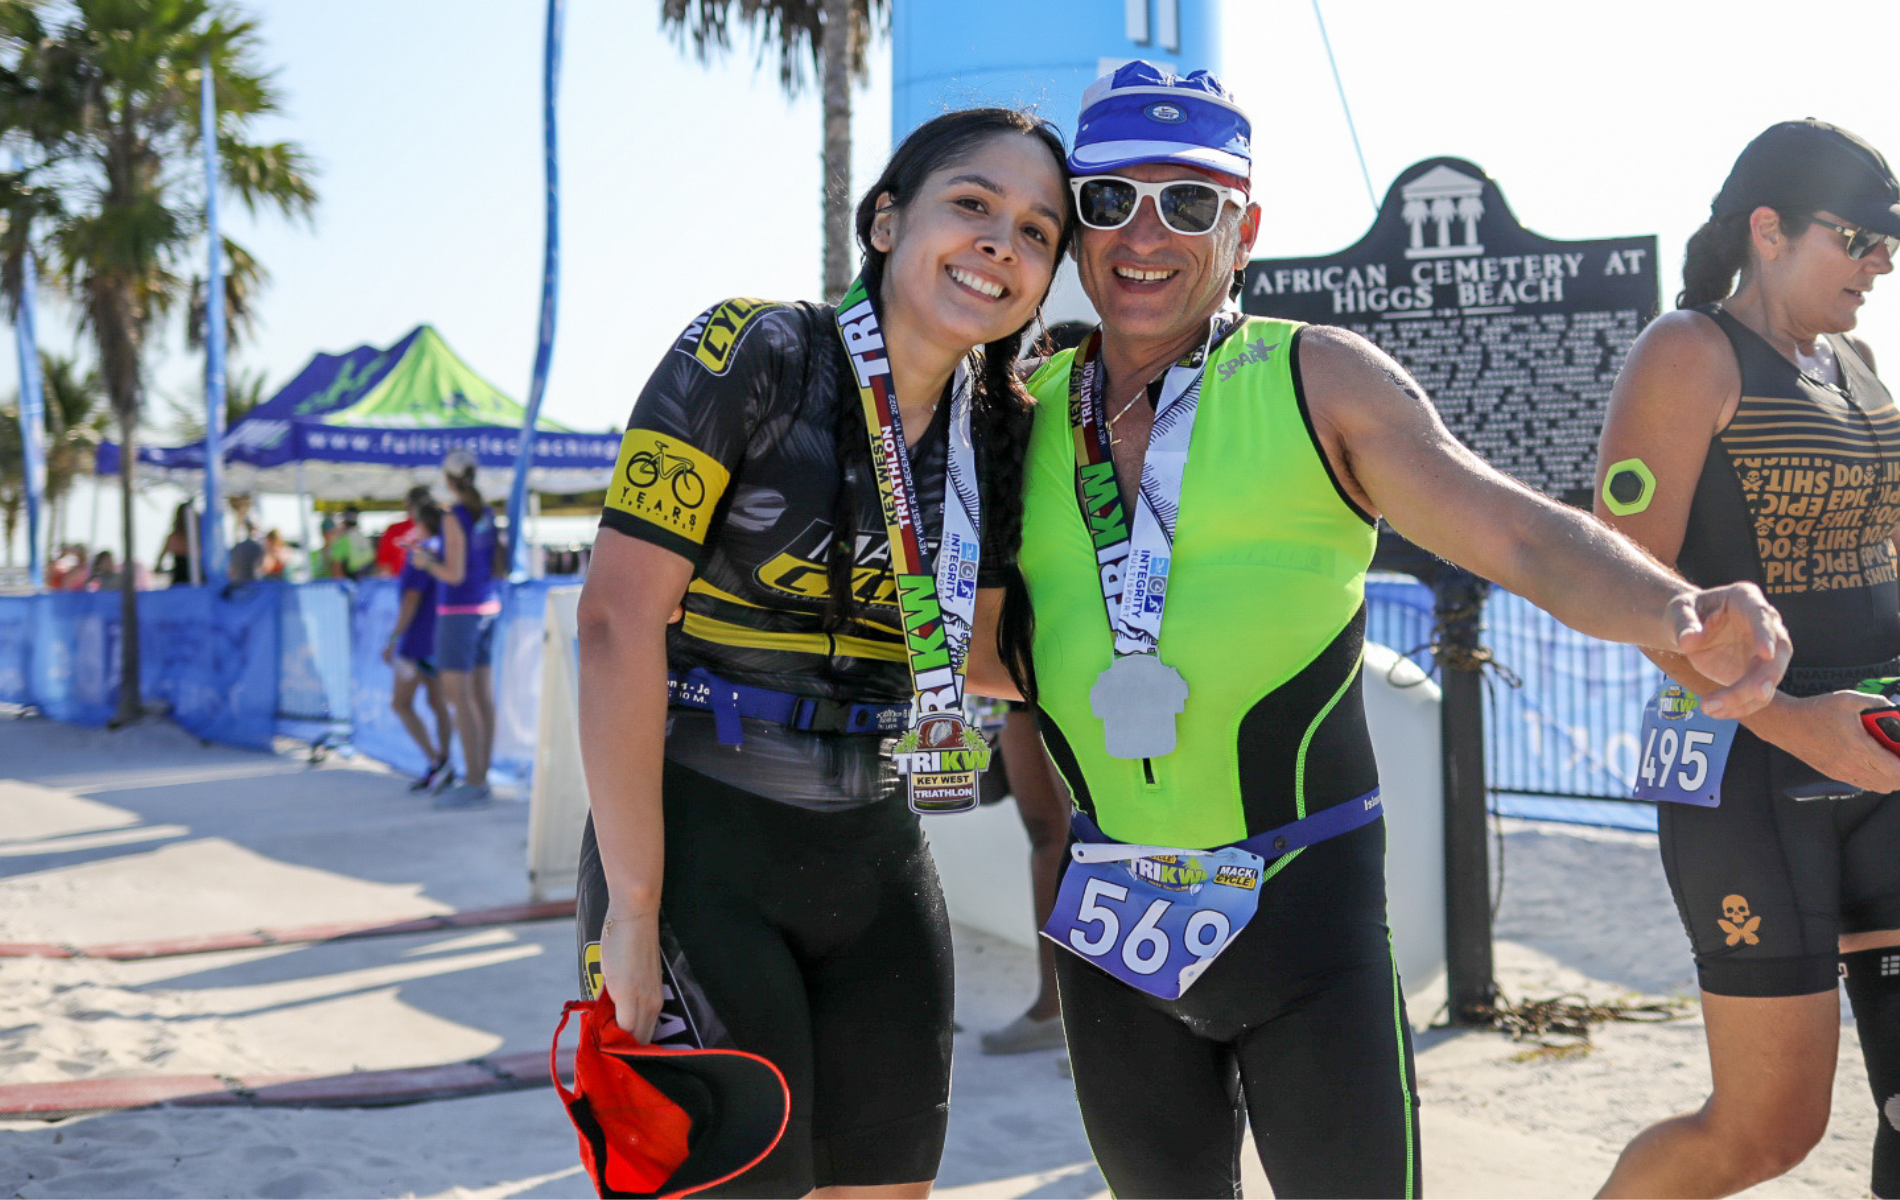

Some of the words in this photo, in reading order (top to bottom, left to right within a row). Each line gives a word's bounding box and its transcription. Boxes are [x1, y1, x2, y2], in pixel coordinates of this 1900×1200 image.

[1253, 264, 1387, 295] AFRICAN
[1411, 253, 1584, 286] CEMETERY
[1604, 249, 1646, 275] AT
[1333, 286, 1433, 313] HIGGS
[1457, 279, 1564, 306] BEACH
[1070, 361, 1083, 397] WEST
[888, 393, 898, 414] 2022
[1080, 361, 1095, 428] TRIATHLON
[1069, 400, 1081, 428] KEY
[870, 433, 889, 484] WEST
[896, 434, 912, 486] DECEMBER
[881, 425, 909, 529] TRIATHLON
[1762, 469, 1830, 494] SHIT.
[1834, 464, 1863, 487] DO
[623, 486, 697, 526] YEARS
[883, 490, 899, 526] KEY
[1760, 493, 1825, 517] EPIC
[1827, 488, 1872, 511] EPIC
[1775, 518, 1816, 536] DO
[1817, 509, 1865, 530] SHIT.
[918, 536, 928, 555] KEY
[1811, 530, 1860, 551] SHIT.
[938, 531, 950, 601] MULTISPORT
[945, 533, 960, 603] INTEGRITY
[1762, 560, 1807, 584] PIC
[1812, 551, 1860, 575] EPIC
[1122, 549, 1139, 618] MULTISPORT
[1131, 549, 1151, 619] INTEGRITY
[1660, 697, 1696, 712] TRIKW
[891, 748, 991, 774] TRIKW
[1640, 727, 1716, 793] 495
[915, 787, 973, 798] TRIATHLON
[917, 776, 940, 785] KEY
[941, 775, 970, 785] WEST
[1130, 858, 1205, 885] TRIKW
[1214, 874, 1251, 886] CYCLE
[1069, 877, 1231, 975] 569
